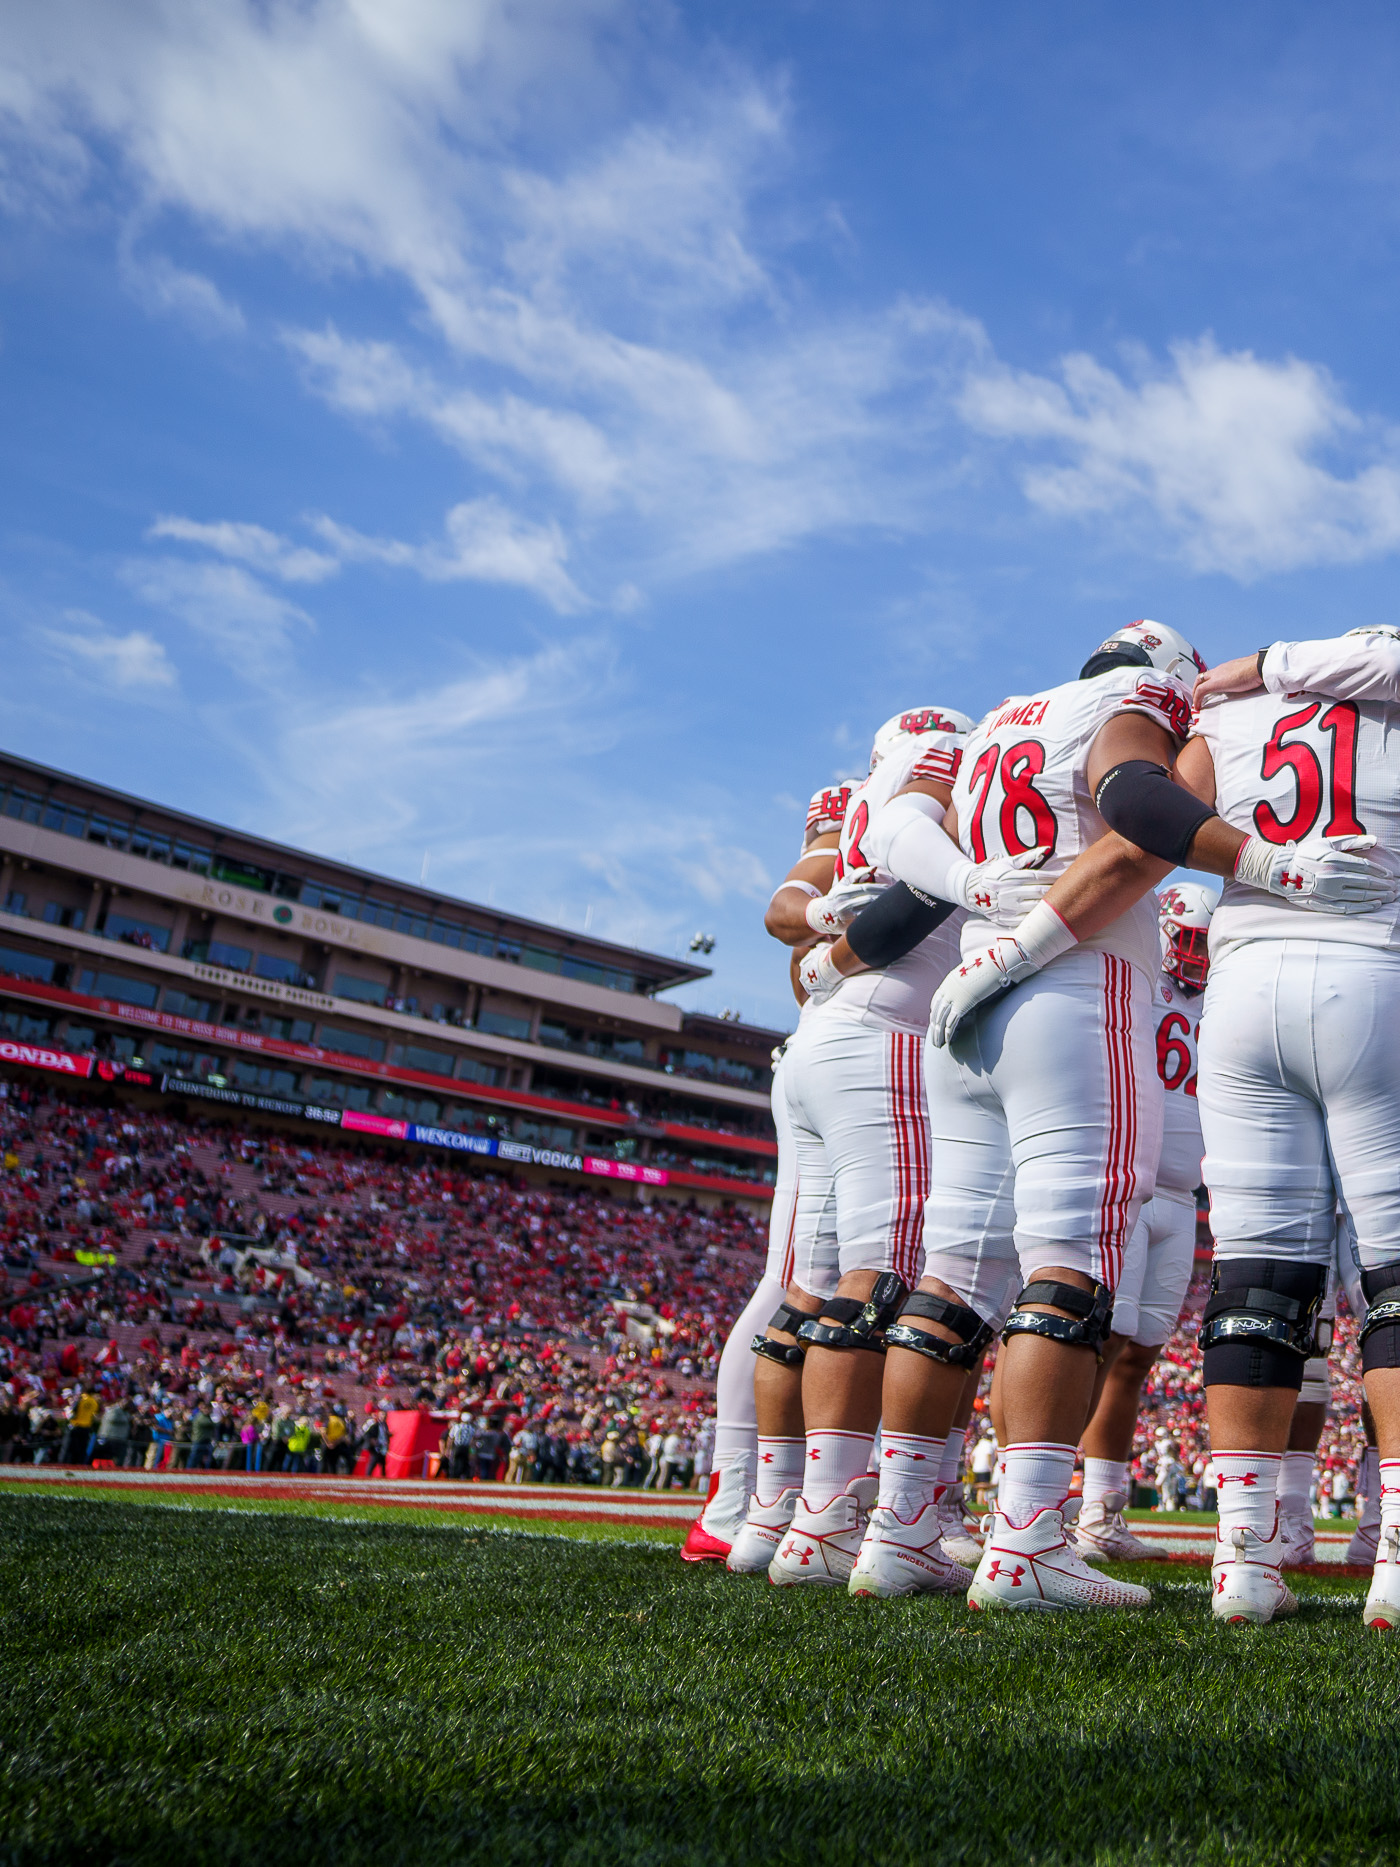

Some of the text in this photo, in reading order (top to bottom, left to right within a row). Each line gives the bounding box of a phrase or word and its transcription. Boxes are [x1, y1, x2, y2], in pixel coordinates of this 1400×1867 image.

[1253, 700, 1367, 846] 51
[969, 739, 1058, 870] 78
[0, 1042, 76, 1072] ONDA
[168, 1079, 240, 1104] COUNTDOWN
[242, 1093, 255, 1106] TO
[257, 1095, 302, 1116] KICKOFF
[415, 1125, 475, 1150] WESCOM
[532, 1148, 583, 1171] VODKA
[757, 1531, 781, 1544] UNDE
[896, 1551, 925, 1569] UNDER
